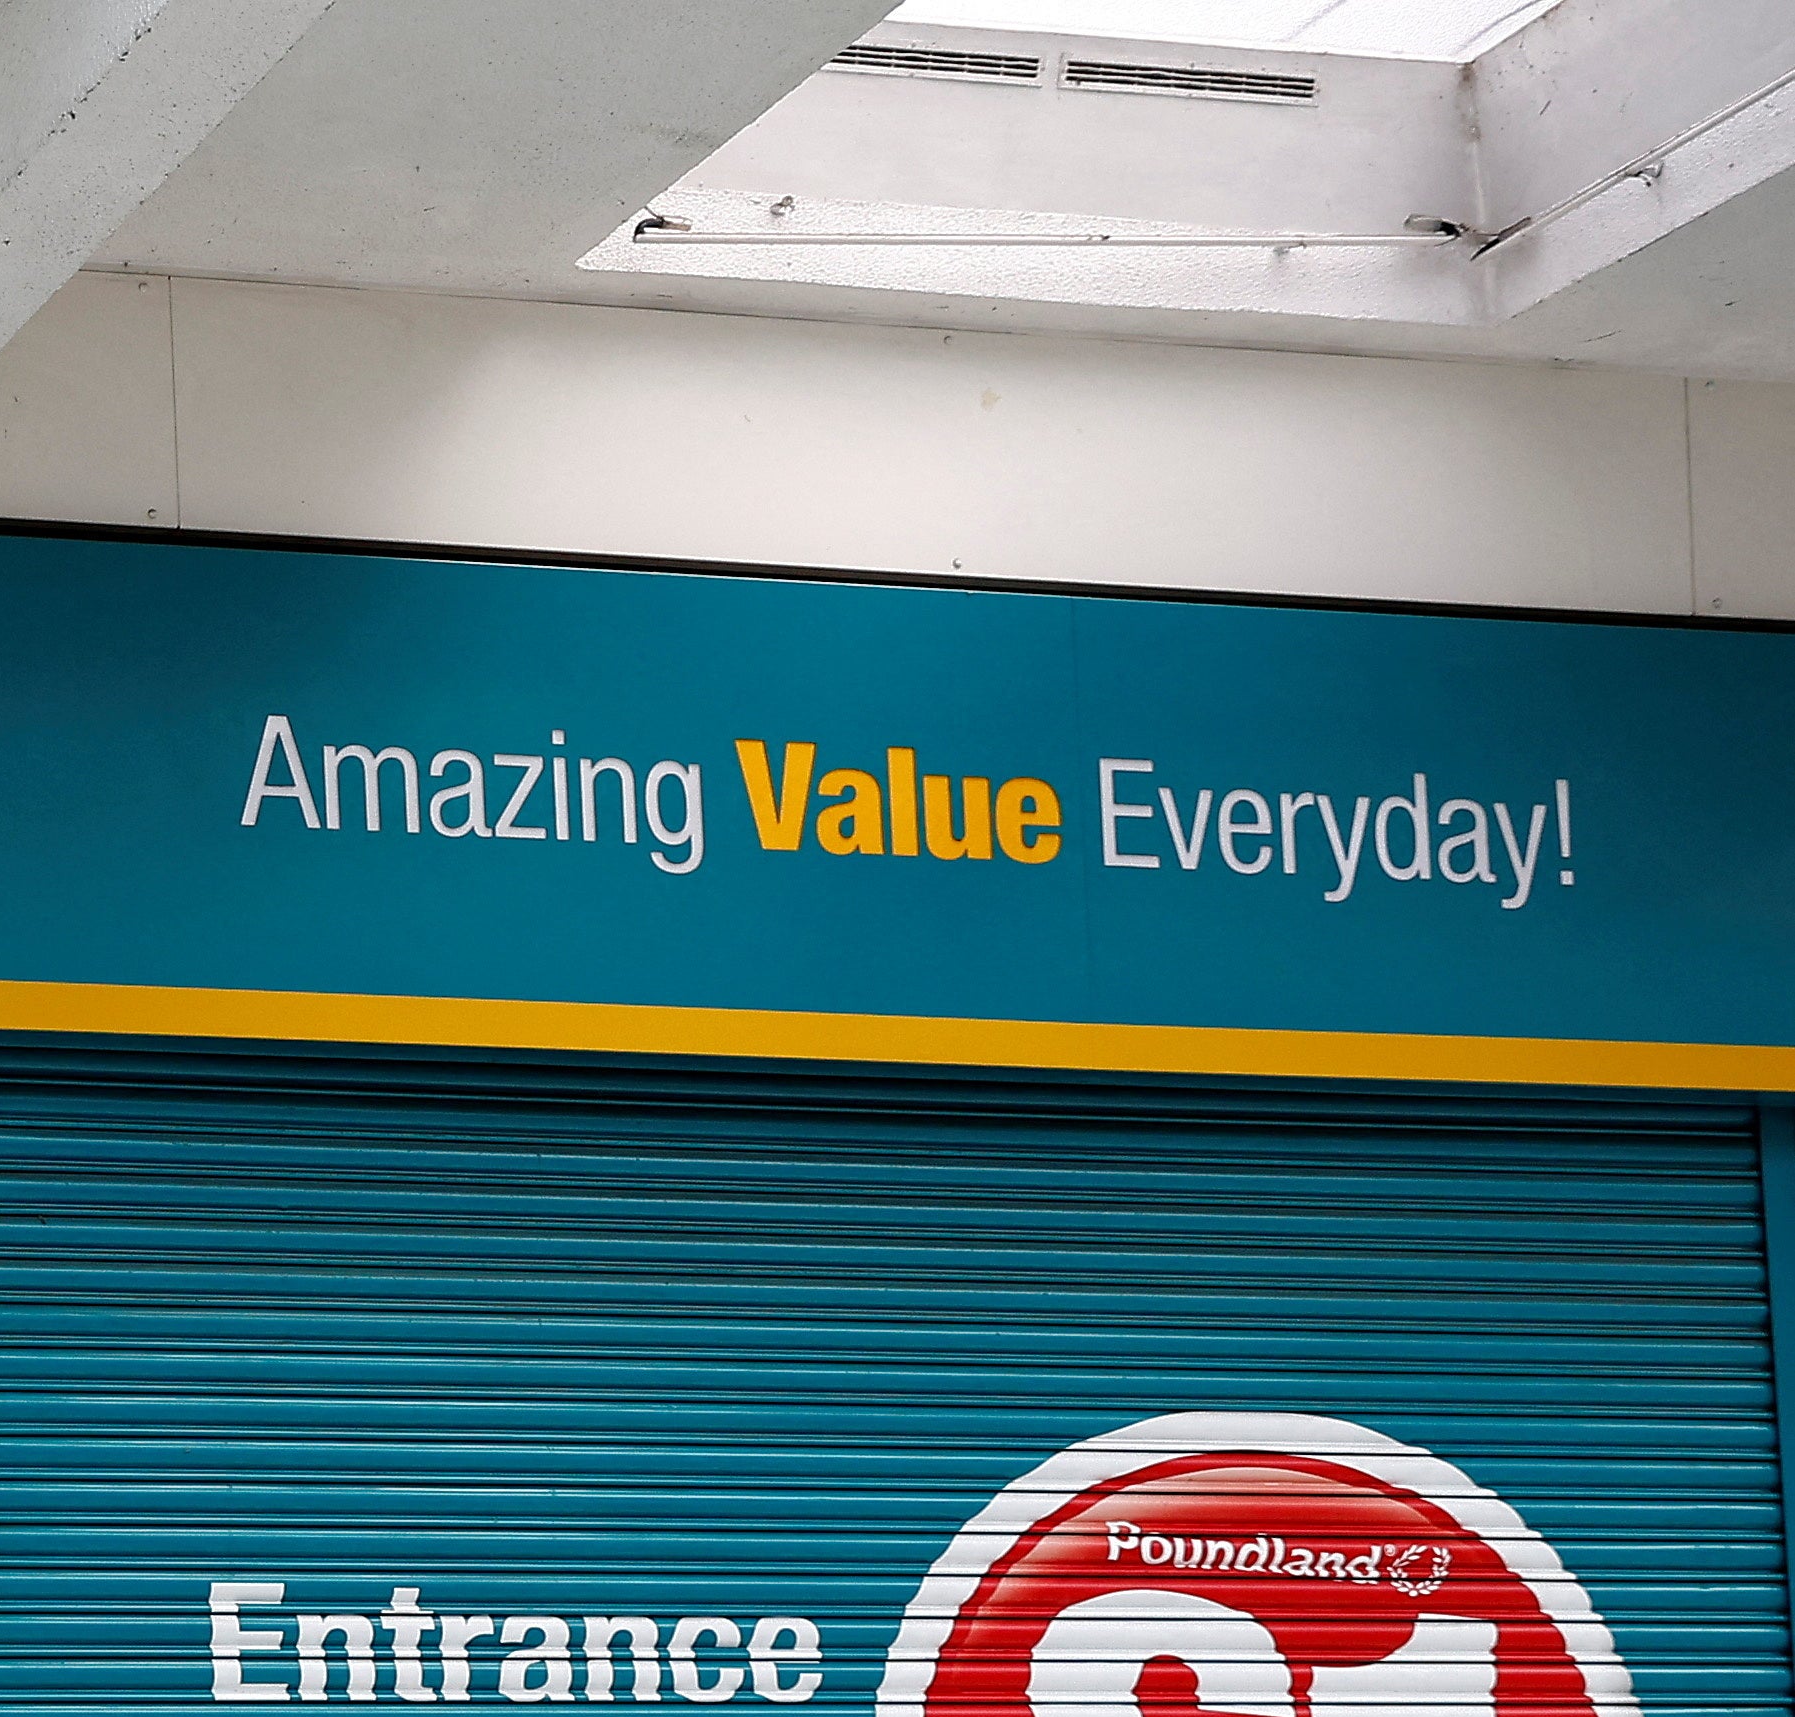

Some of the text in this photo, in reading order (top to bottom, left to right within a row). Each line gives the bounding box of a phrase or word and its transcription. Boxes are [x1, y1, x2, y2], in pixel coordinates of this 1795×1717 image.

[241, 713, 1577, 909] Amazing Value Everyday!
[209, 1581, 823, 1703] Entrance
